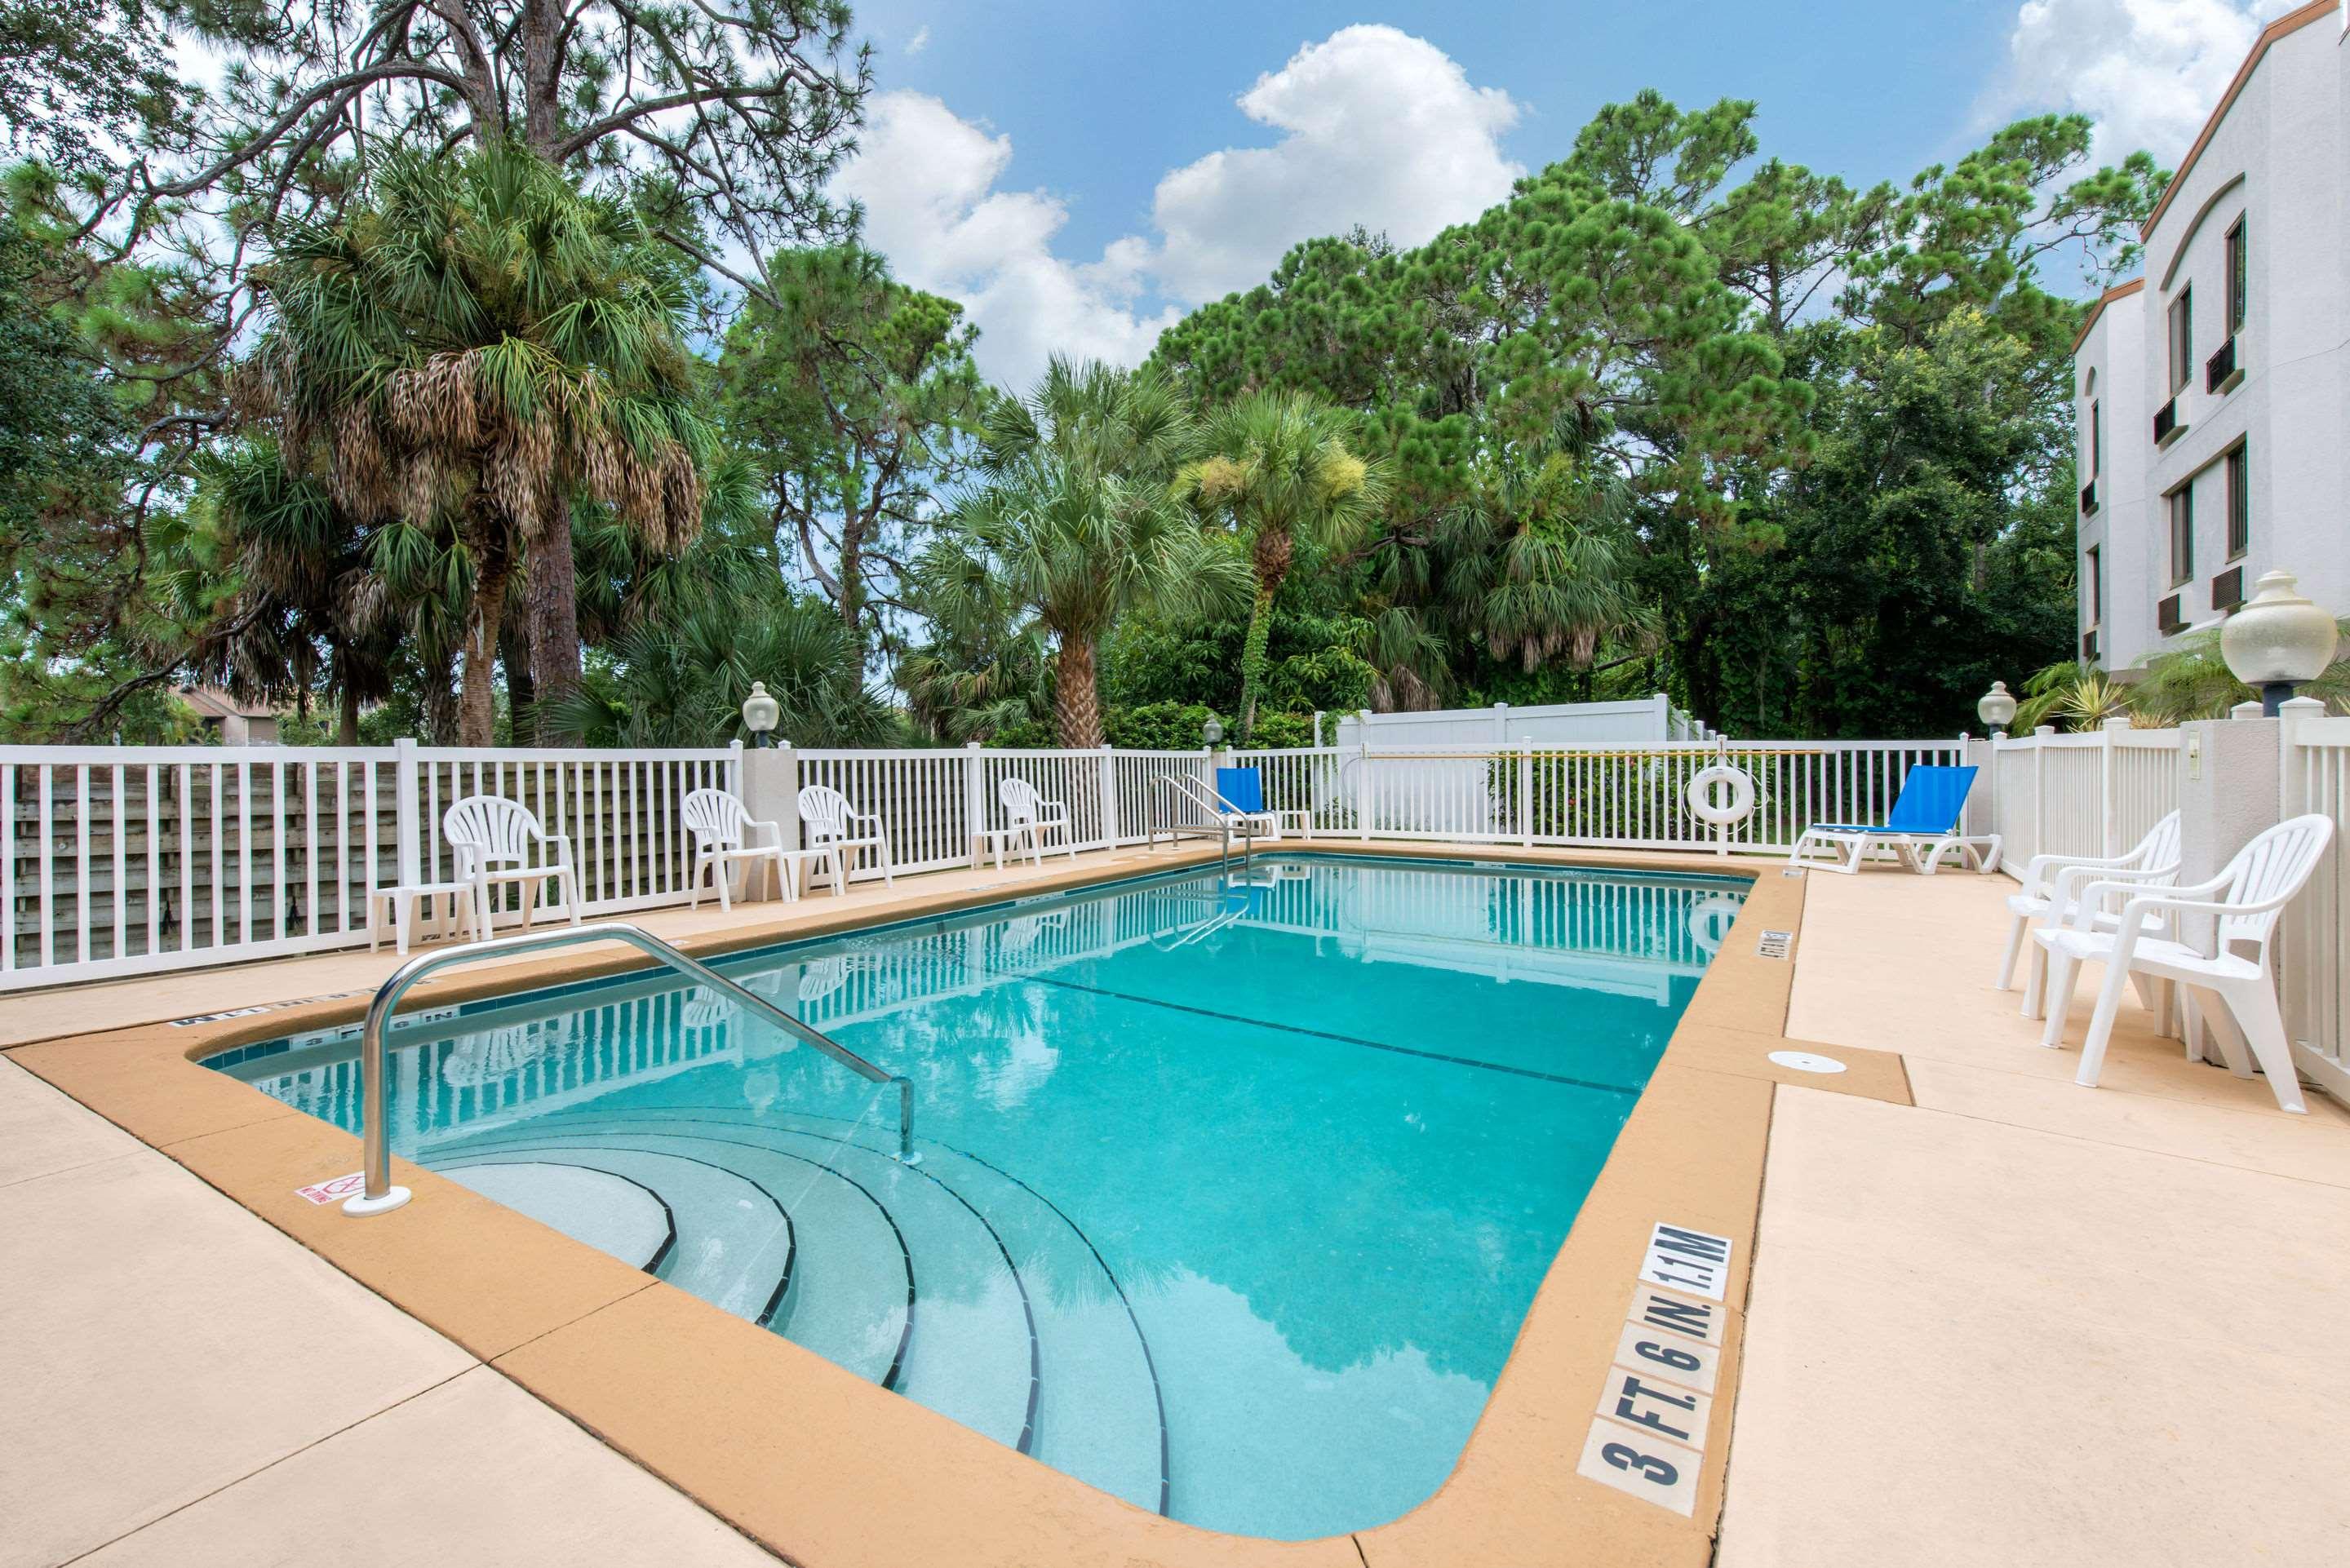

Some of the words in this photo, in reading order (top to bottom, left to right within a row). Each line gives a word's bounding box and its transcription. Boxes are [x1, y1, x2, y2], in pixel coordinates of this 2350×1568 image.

[1643, 1295, 1712, 1339] IN.
[1634, 1340, 1701, 1371] 6
[1614, 1375, 1697, 1441] FT.
[1601, 1442, 1678, 1486] 3
